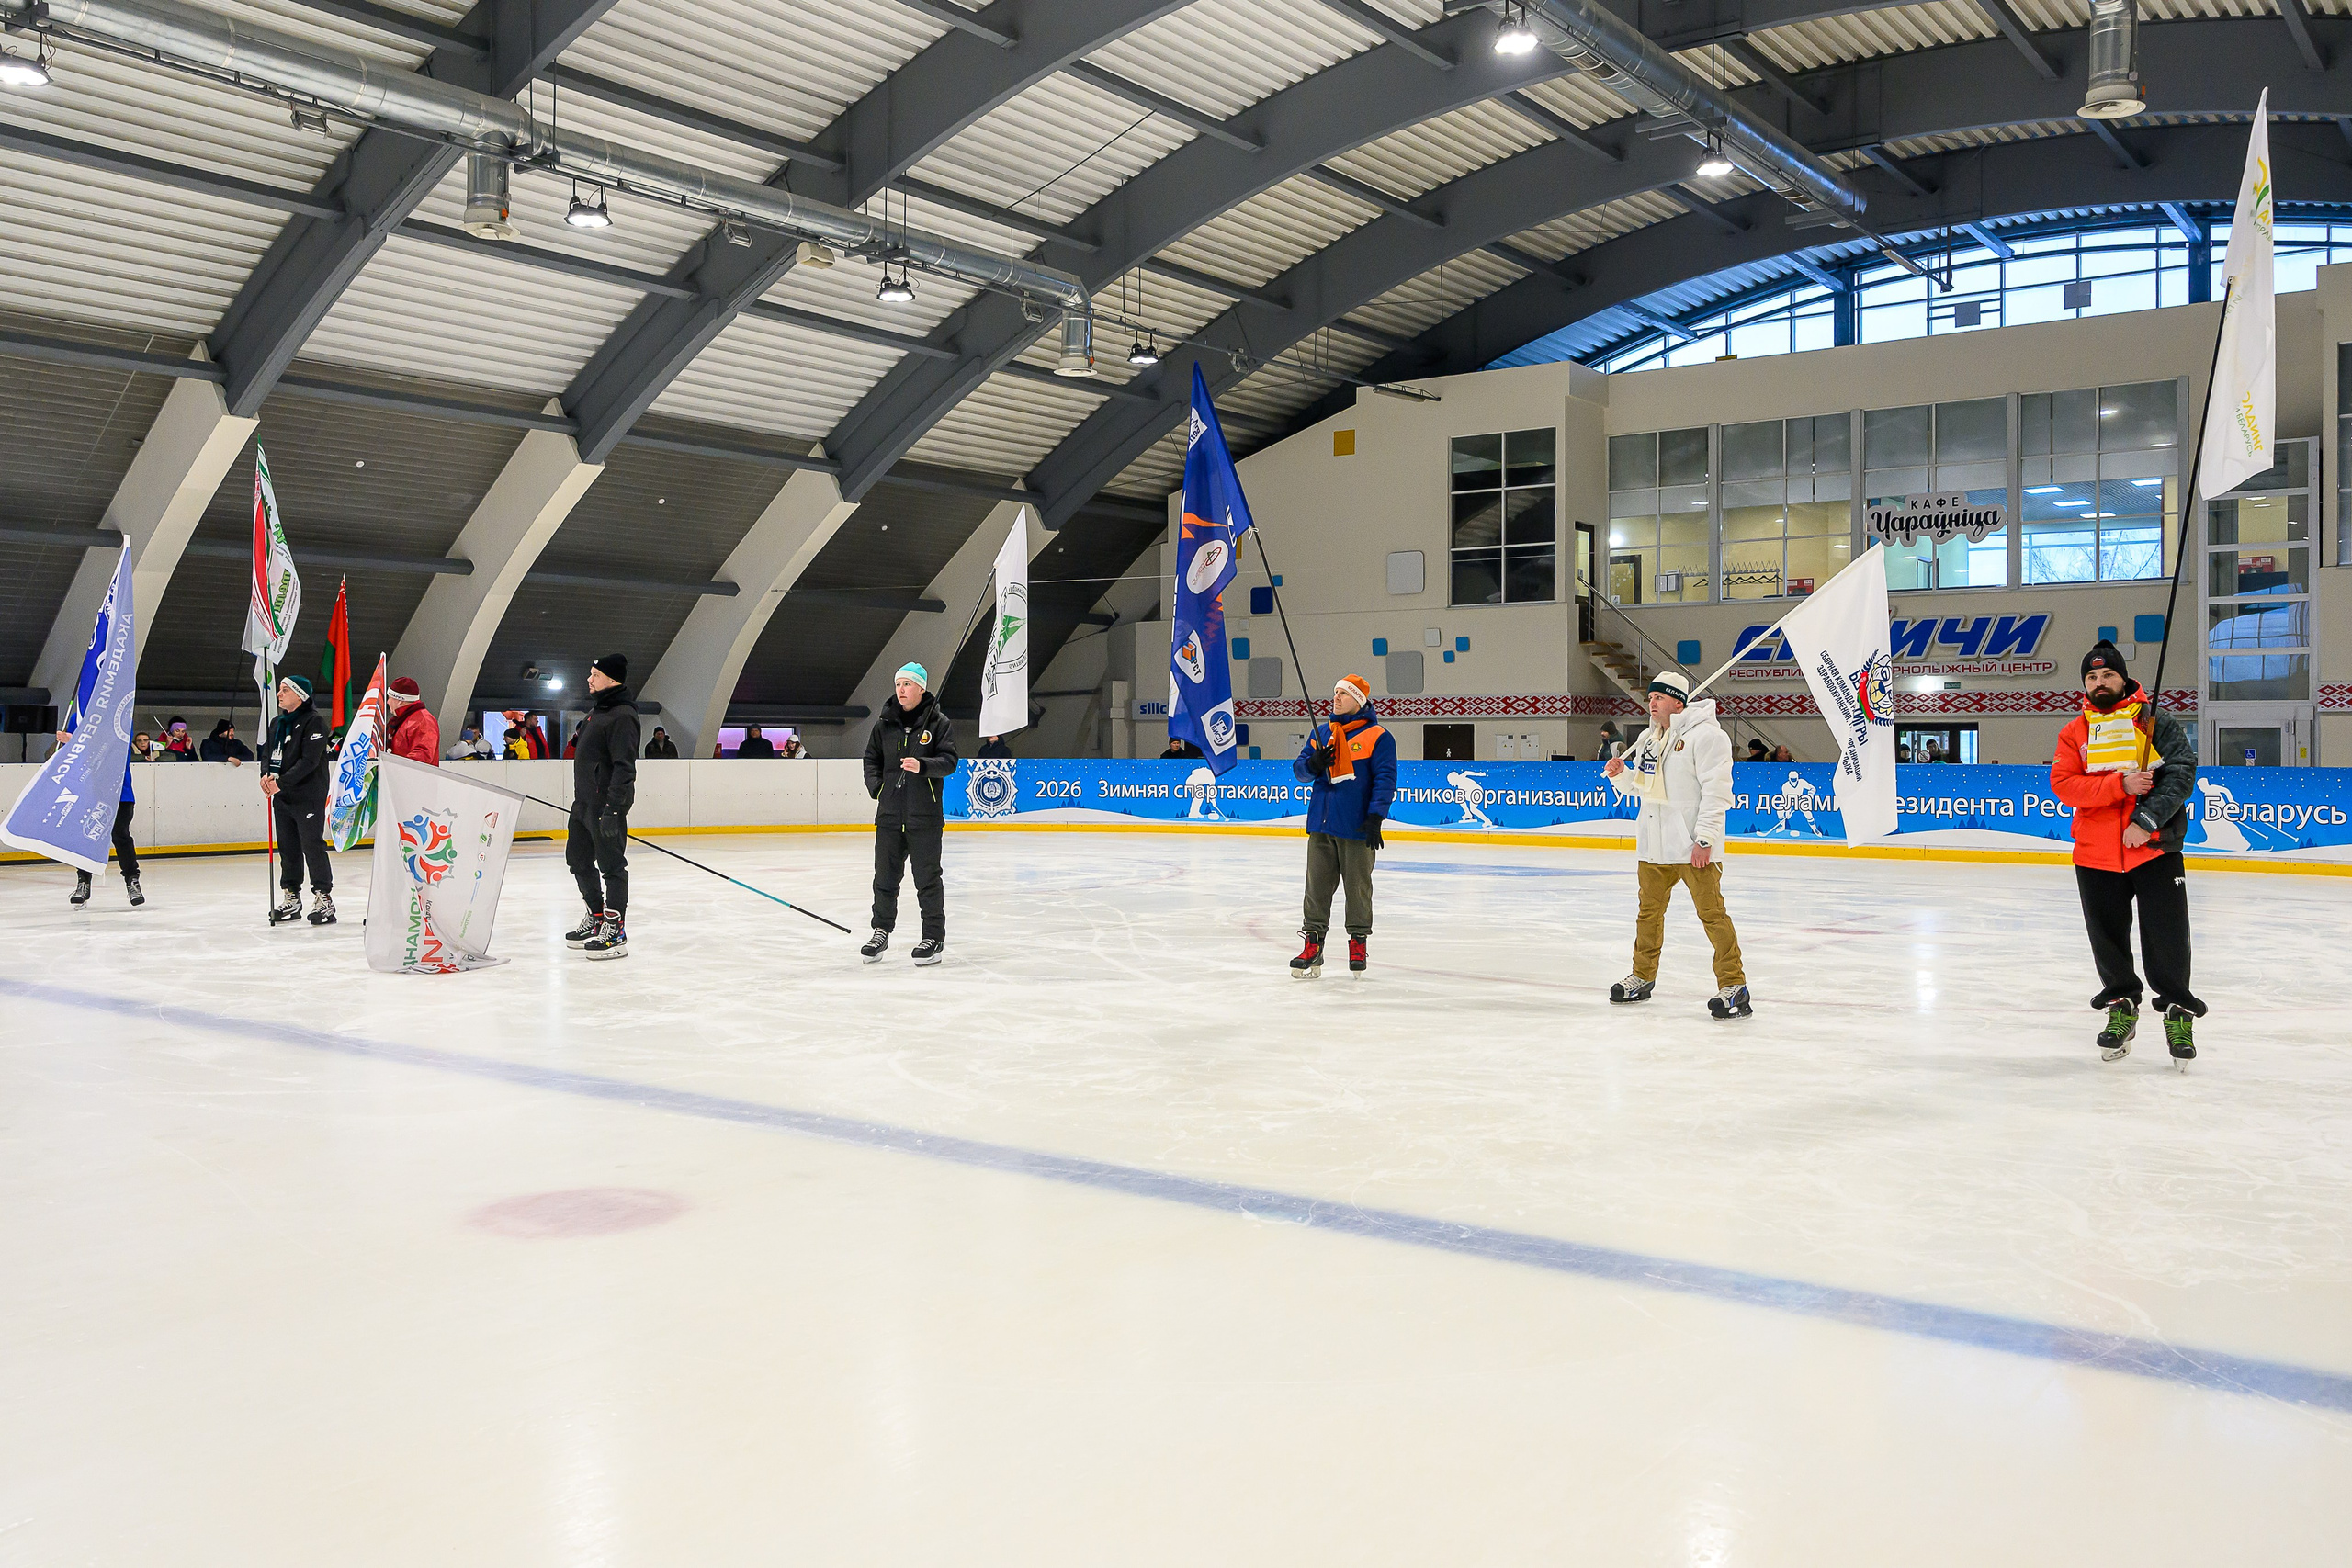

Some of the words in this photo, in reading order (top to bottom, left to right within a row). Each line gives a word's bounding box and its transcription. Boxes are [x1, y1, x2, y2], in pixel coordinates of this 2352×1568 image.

[2235, 412, 2254, 457] БЕЛАРУСЬ
[1911, 497, 1959, 510] КАФЕ
[1729, 668, 1804, 678] РЕСПУБЛИ
[1892, 661, 1997, 674] РНОЛЫЖНЫЙ
[2001, 662, 2052, 675] ЦЕНТР
[1819, 649, 1840, 678] СБОРНАЯ
[1834, 675, 1857, 706] КОМАНДА
[1139, 702, 1167, 715] silic
[1035, 780, 1082, 798] 2026
[1098, 780, 1169, 798] Зимняя
[1173, 784, 1289, 803] спартакиада
[1471, 785, 1606, 810] организаций
[1895, 795, 2014, 819] езидента
[2204, 796, 2348, 830] Беларусь
